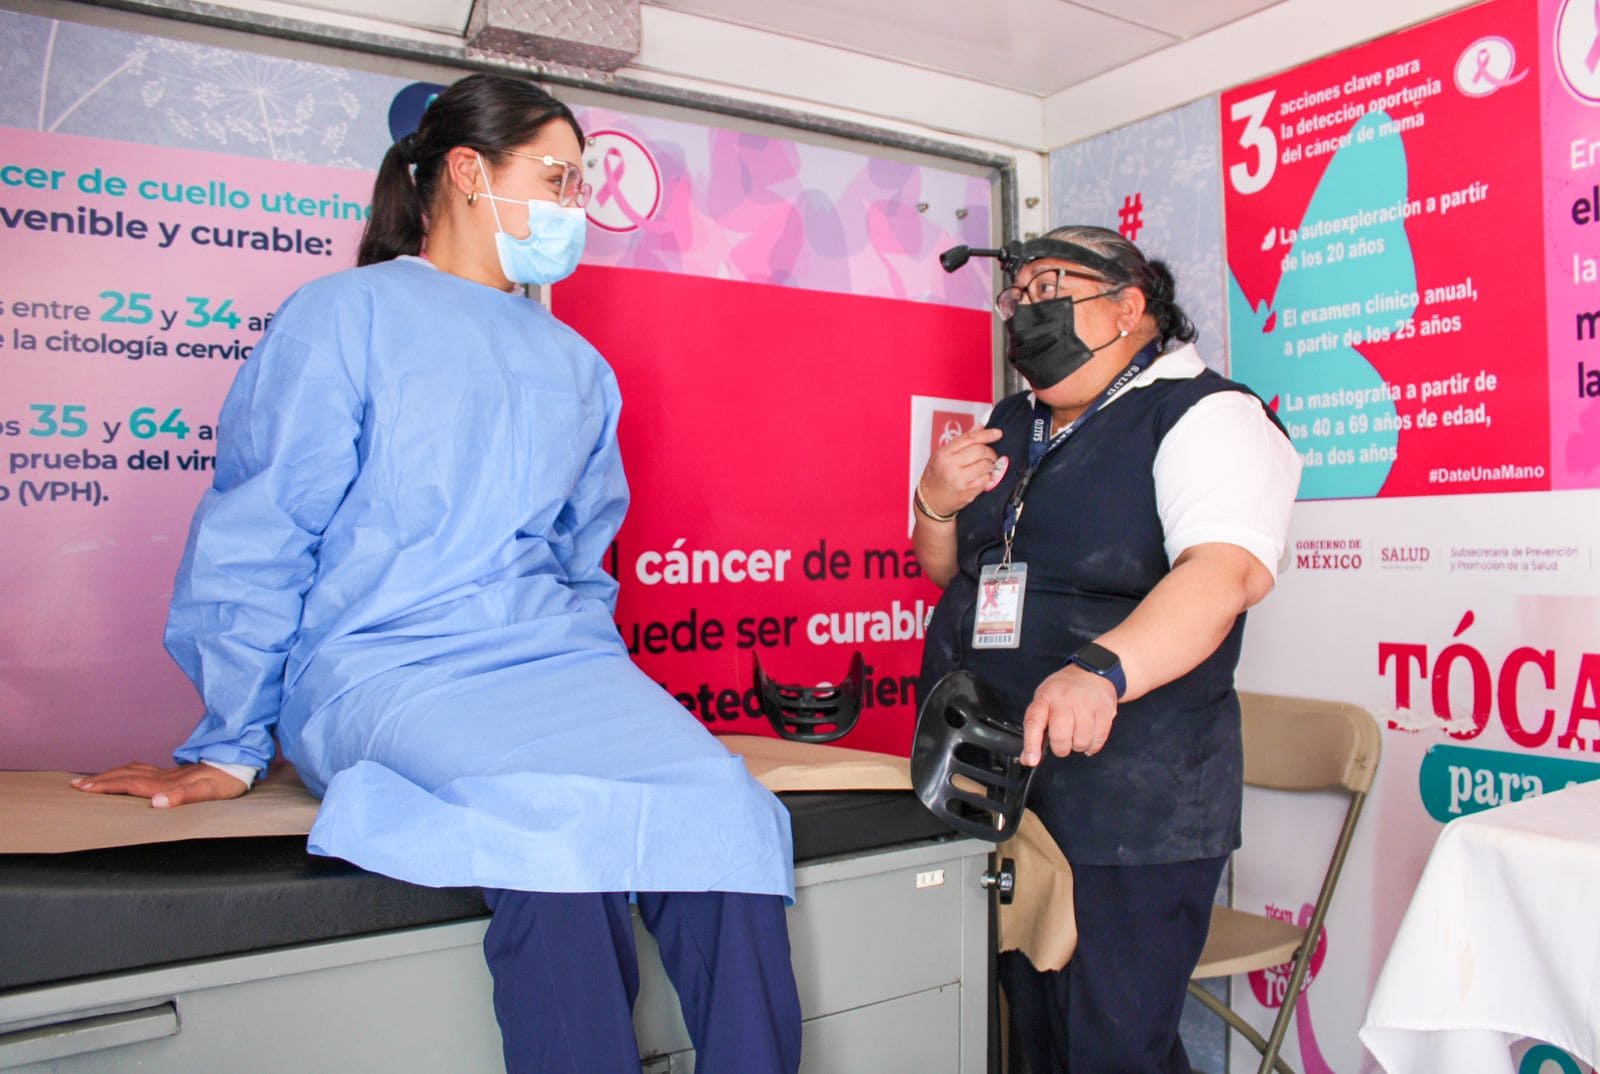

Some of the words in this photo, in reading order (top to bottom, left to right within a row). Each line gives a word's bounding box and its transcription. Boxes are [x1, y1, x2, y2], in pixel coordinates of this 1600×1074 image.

[1280, 85, 1341, 116] acciones
[1344, 72, 1382, 95] clave
[1385, 59, 1421, 86] para
[1281, 124, 1294, 140] la
[1297, 101, 1365, 135] detección
[1368, 79, 1442, 115] oportunia
[1229, 90, 1278, 195] 3
[1282, 143, 1302, 165] del
[1305, 131, 1353, 158] cáncer
[1357, 125, 1375, 143] de
[1379, 111, 1425, 137] mama
[0, 165, 66, 190] cer
[77, 168, 127, 197] de
[138, 181, 251, 210] cuello
[0, 206, 149, 240] venible
[158, 221, 181, 248] y
[190, 226, 333, 257] curable:
[1280, 227, 1298, 245] La
[1301, 198, 1422, 241] autoexploración
[1426, 197, 1436, 212] a
[1440, 182, 1489, 215] partir
[1281, 255, 1297, 273] de
[1302, 250, 1322, 269] los
[1327, 242, 1344, 264] 20
[1350, 236, 1385, 258] años
[1573, 253, 1598, 284] la
[12, 300, 91, 321] entre
[99, 290, 154, 325] 25
[160, 309, 178, 331] y
[185, 296, 242, 330] 34
[1283, 308, 1296, 328] El
[1301, 295, 1361, 325] examen
[1424, 276, 1478, 306] anual,
[13, 328, 37, 351] la
[45, 330, 169, 360] citología
[1284, 342, 1294, 356] a
[1297, 332, 1339, 359] partir
[1343, 327, 1363, 347] de
[1366, 324, 1391, 344] los
[1395, 316, 1416, 341] 25
[1420, 314, 1463, 337] años
[1106, 364, 1140, 397] SALUD
[1286, 391, 1304, 412] La
[1406, 383, 1417, 400] a
[1421, 372, 1471, 403] partir
[1474, 369, 1498, 392] de
[29, 403, 89, 438] 35
[102, 421, 122, 444] y
[128, 406, 190, 440] 64
[1312, 416, 1331, 437] 40
[1335, 420, 1346, 436] a
[1349, 412, 1369, 435] 69
[1373, 411, 1413, 434] años
[1416, 405, 1438, 428] de
[1442, 402, 1493, 428] edad,
[9, 449, 118, 474] prueba
[127, 450, 170, 470] del
[1328, 445, 1356, 465] dos
[1360, 443, 1399, 464] años
[1428, 463, 1546, 484] #DateUnaMano
[18, 480, 109, 507] (VPH).
[635, 538, 791, 586] cáncer
[803, 540, 851, 580] de
[1296, 540, 1346, 550] GOBIERNO
[1349, 540, 1362, 549] DE
[1296, 551, 1362, 569] MÉXICO
[1382, 547, 1430, 561] SALUD
[736, 616, 798, 649] ser
[807, 600, 928, 645] curabl
[1448, 765, 1543, 814] para
